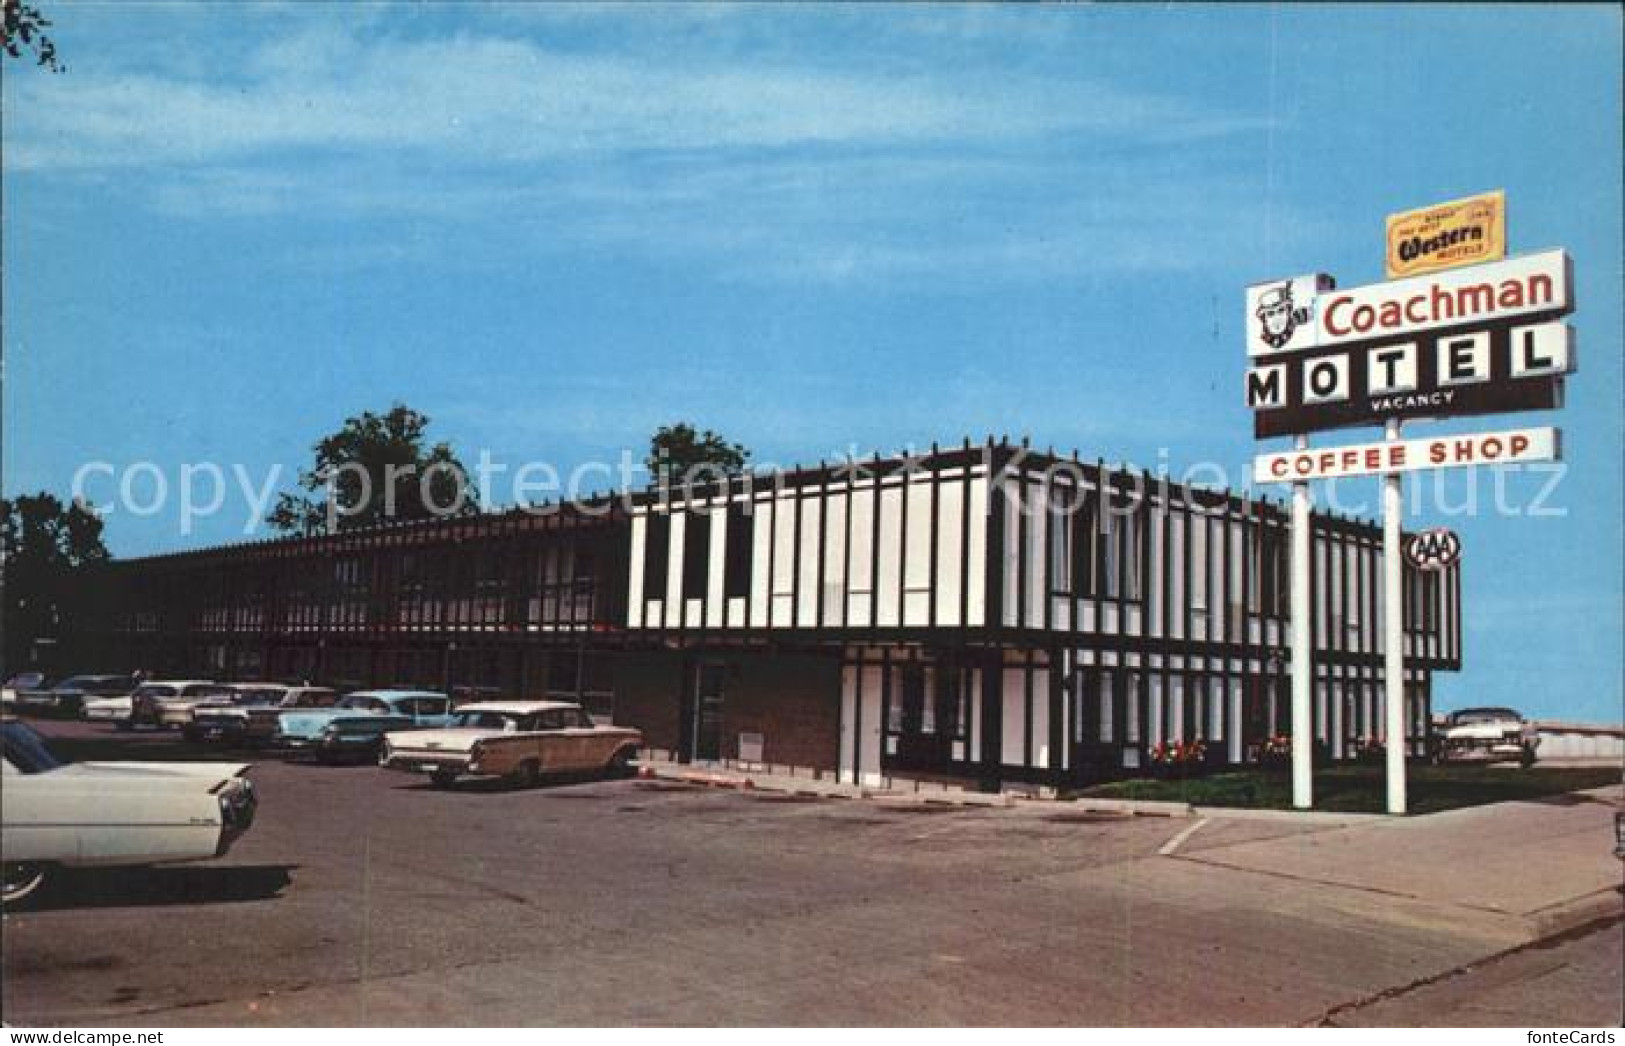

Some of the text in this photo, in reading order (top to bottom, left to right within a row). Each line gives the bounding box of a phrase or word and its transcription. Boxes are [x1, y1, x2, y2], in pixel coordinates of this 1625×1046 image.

[1398, 225, 1483, 263] Western
[1322, 272, 1553, 337] Coachman
[1248, 331, 1553, 406] MOTEL
[1371, 391, 1454, 412] VACANCY
[1270, 434, 1530, 477] COFFEE SHOP
[1413, 534, 1454, 561] AAA
